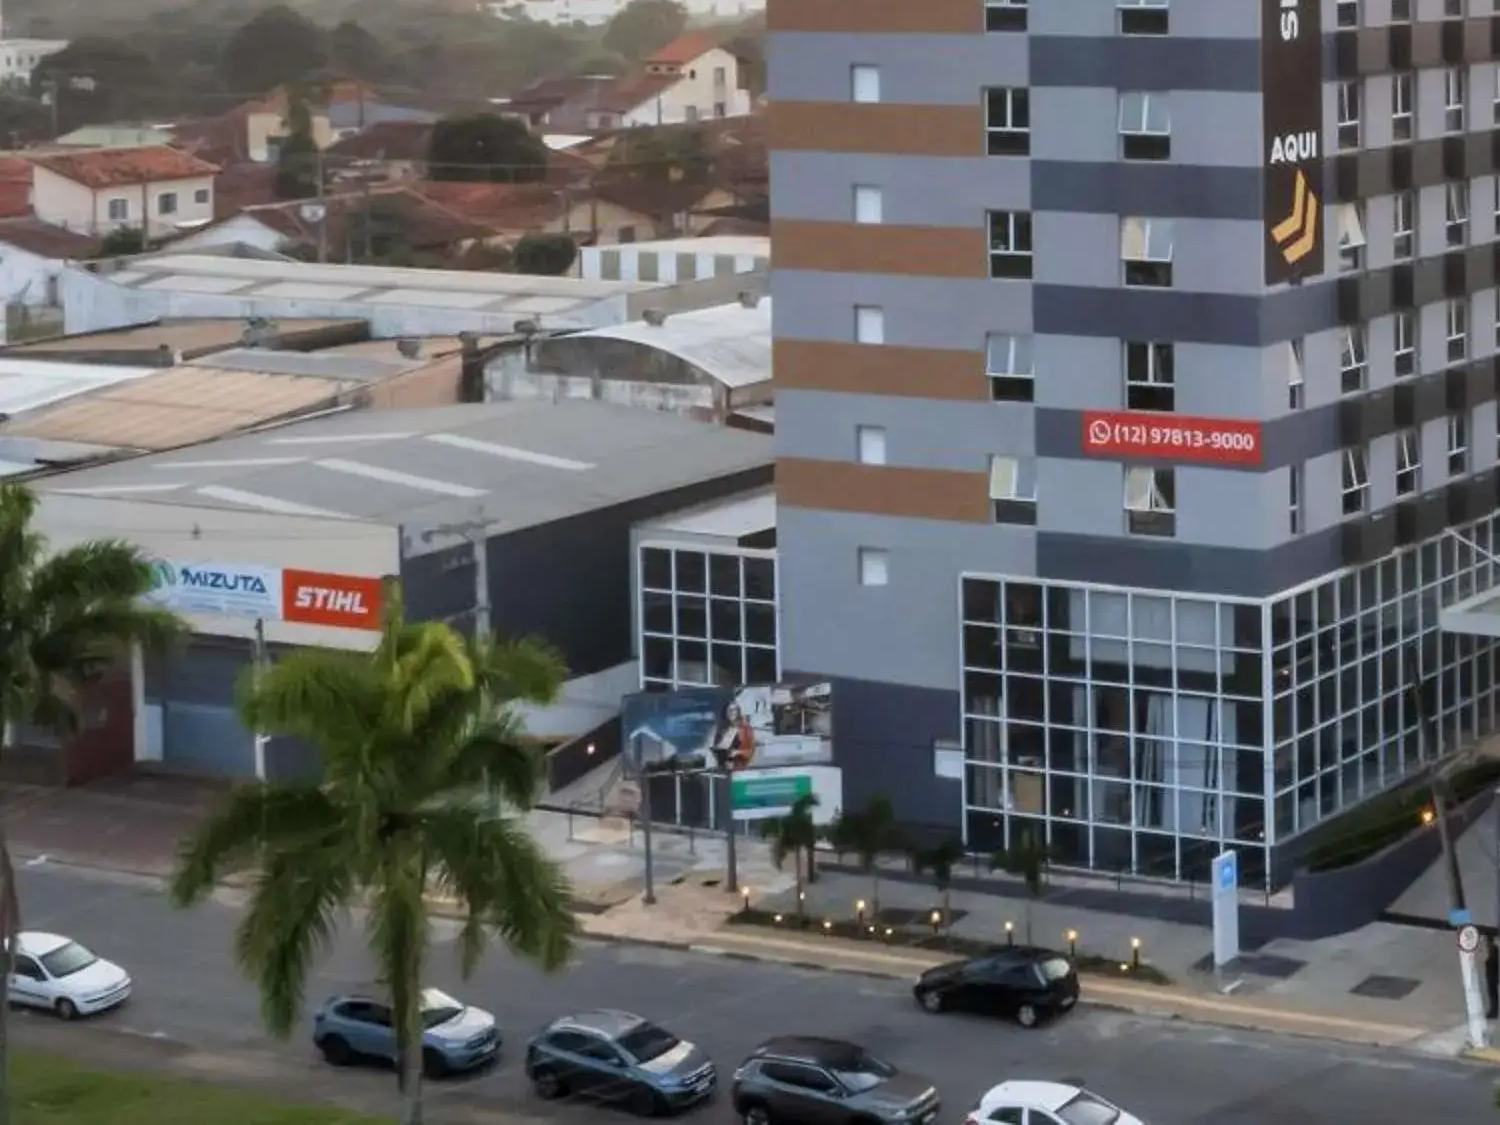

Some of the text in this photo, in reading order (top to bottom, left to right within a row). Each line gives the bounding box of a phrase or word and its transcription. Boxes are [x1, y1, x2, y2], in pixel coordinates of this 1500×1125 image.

[1270, 131, 1318, 164] AQUI
[1114, 423, 1255, 452] (12) 97813-9000
[181, 568, 267, 594] MIZUTA
[294, 586, 369, 615] STIHL
